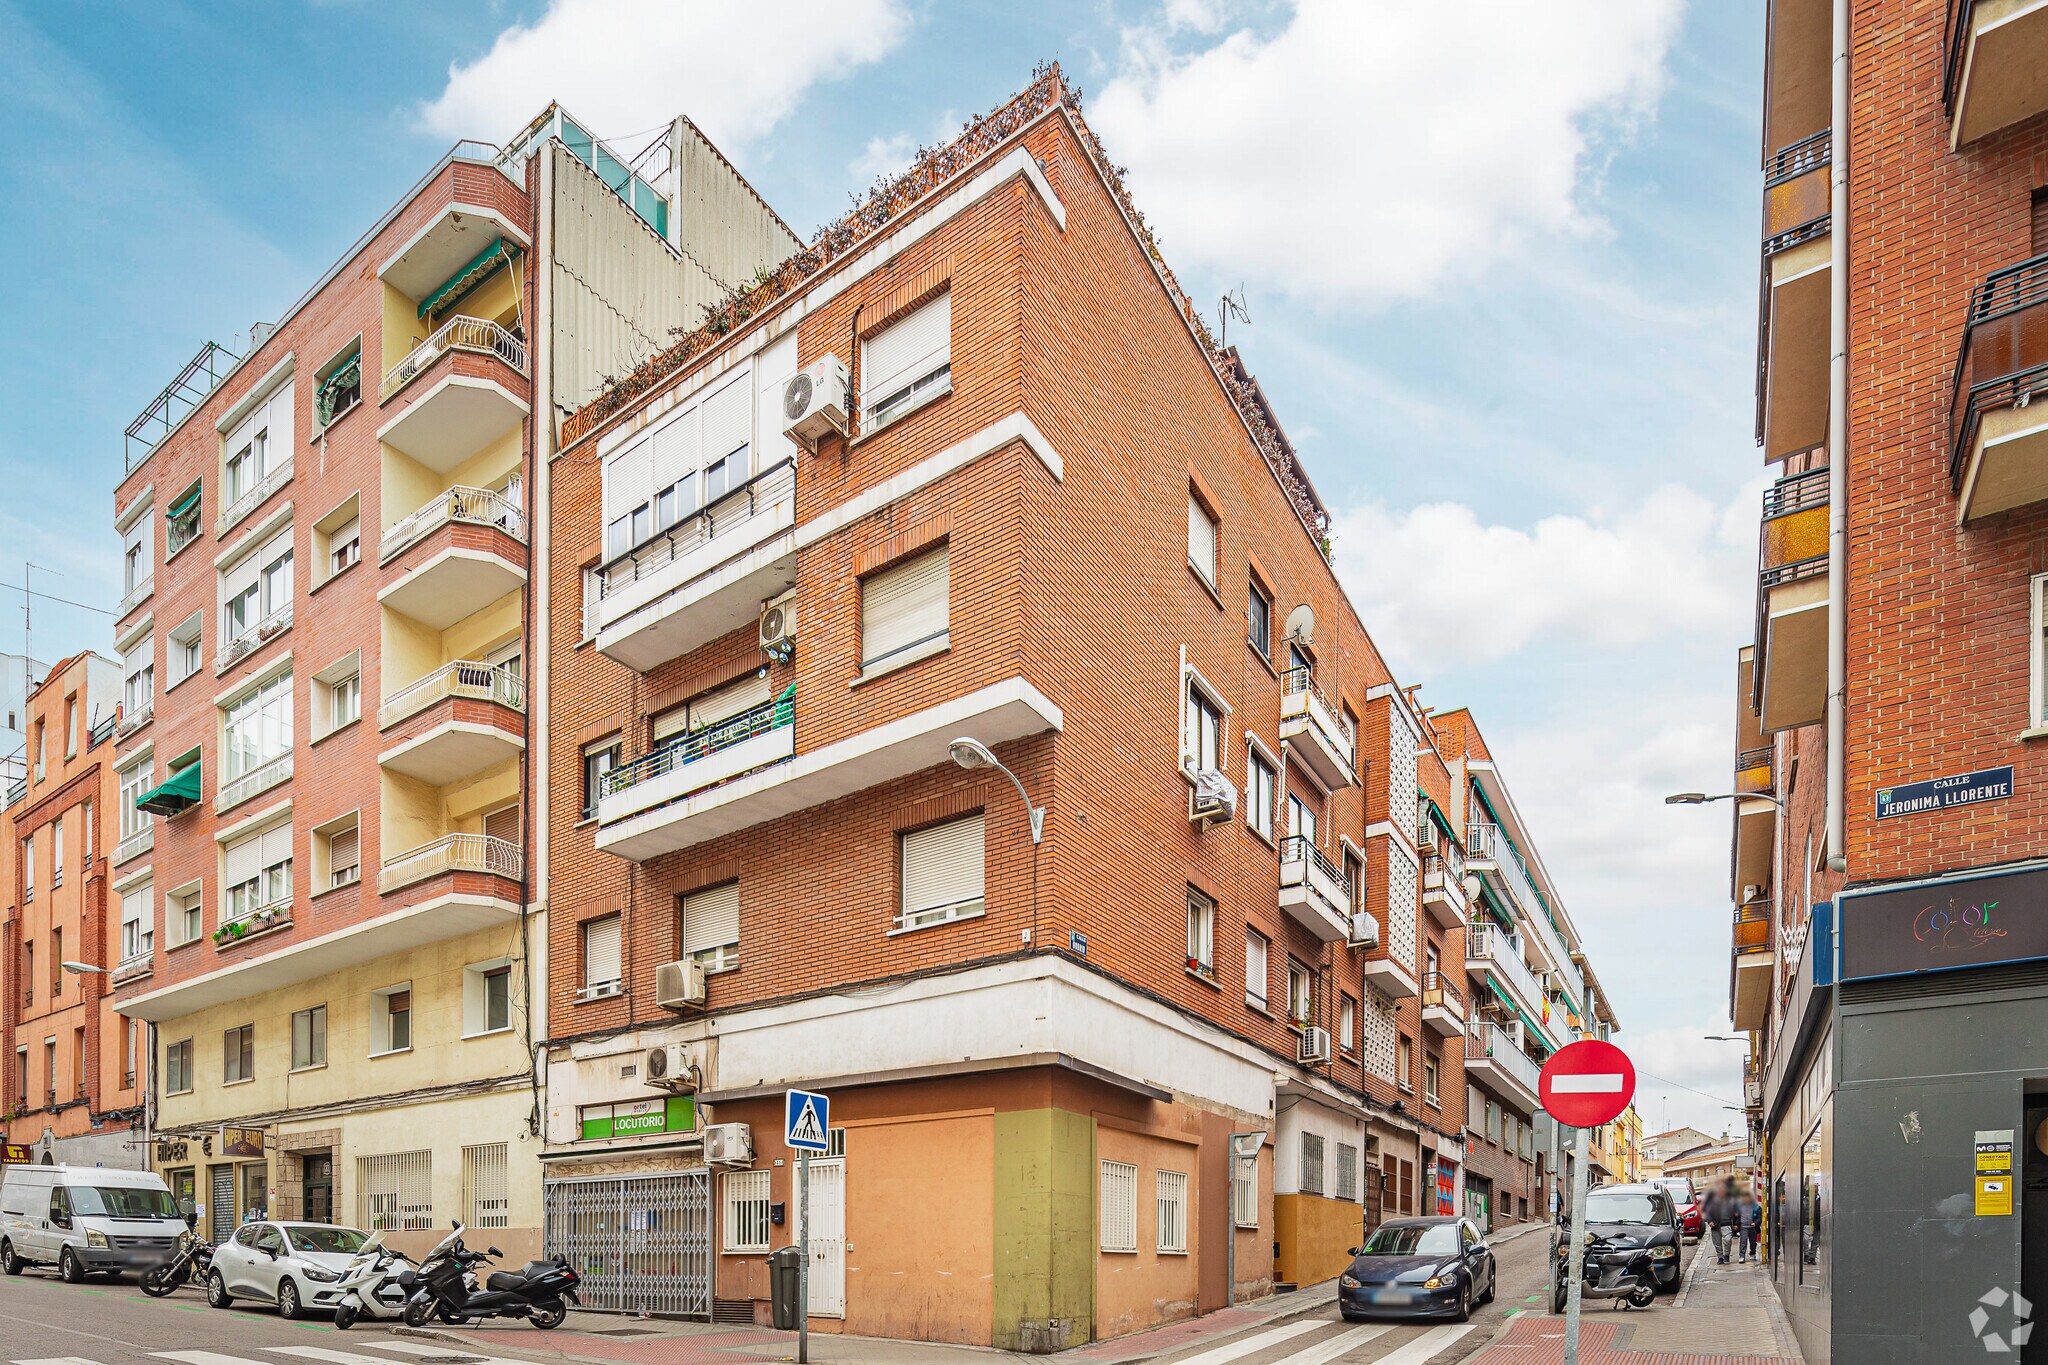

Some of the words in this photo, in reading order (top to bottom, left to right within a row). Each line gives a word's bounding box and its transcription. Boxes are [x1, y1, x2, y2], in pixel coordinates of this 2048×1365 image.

[1933, 776, 1970, 789] CALLE
[1882, 795, 1940, 816] JERONIMA
[1945, 783, 2008, 805] LLORENTE
[614, 1115, 664, 1130] LOCUTORIO
[224, 1128, 242, 1148] HIPER
[245, 1131, 263, 1151] EURO
[157, 1141, 189, 1163] HIPER
